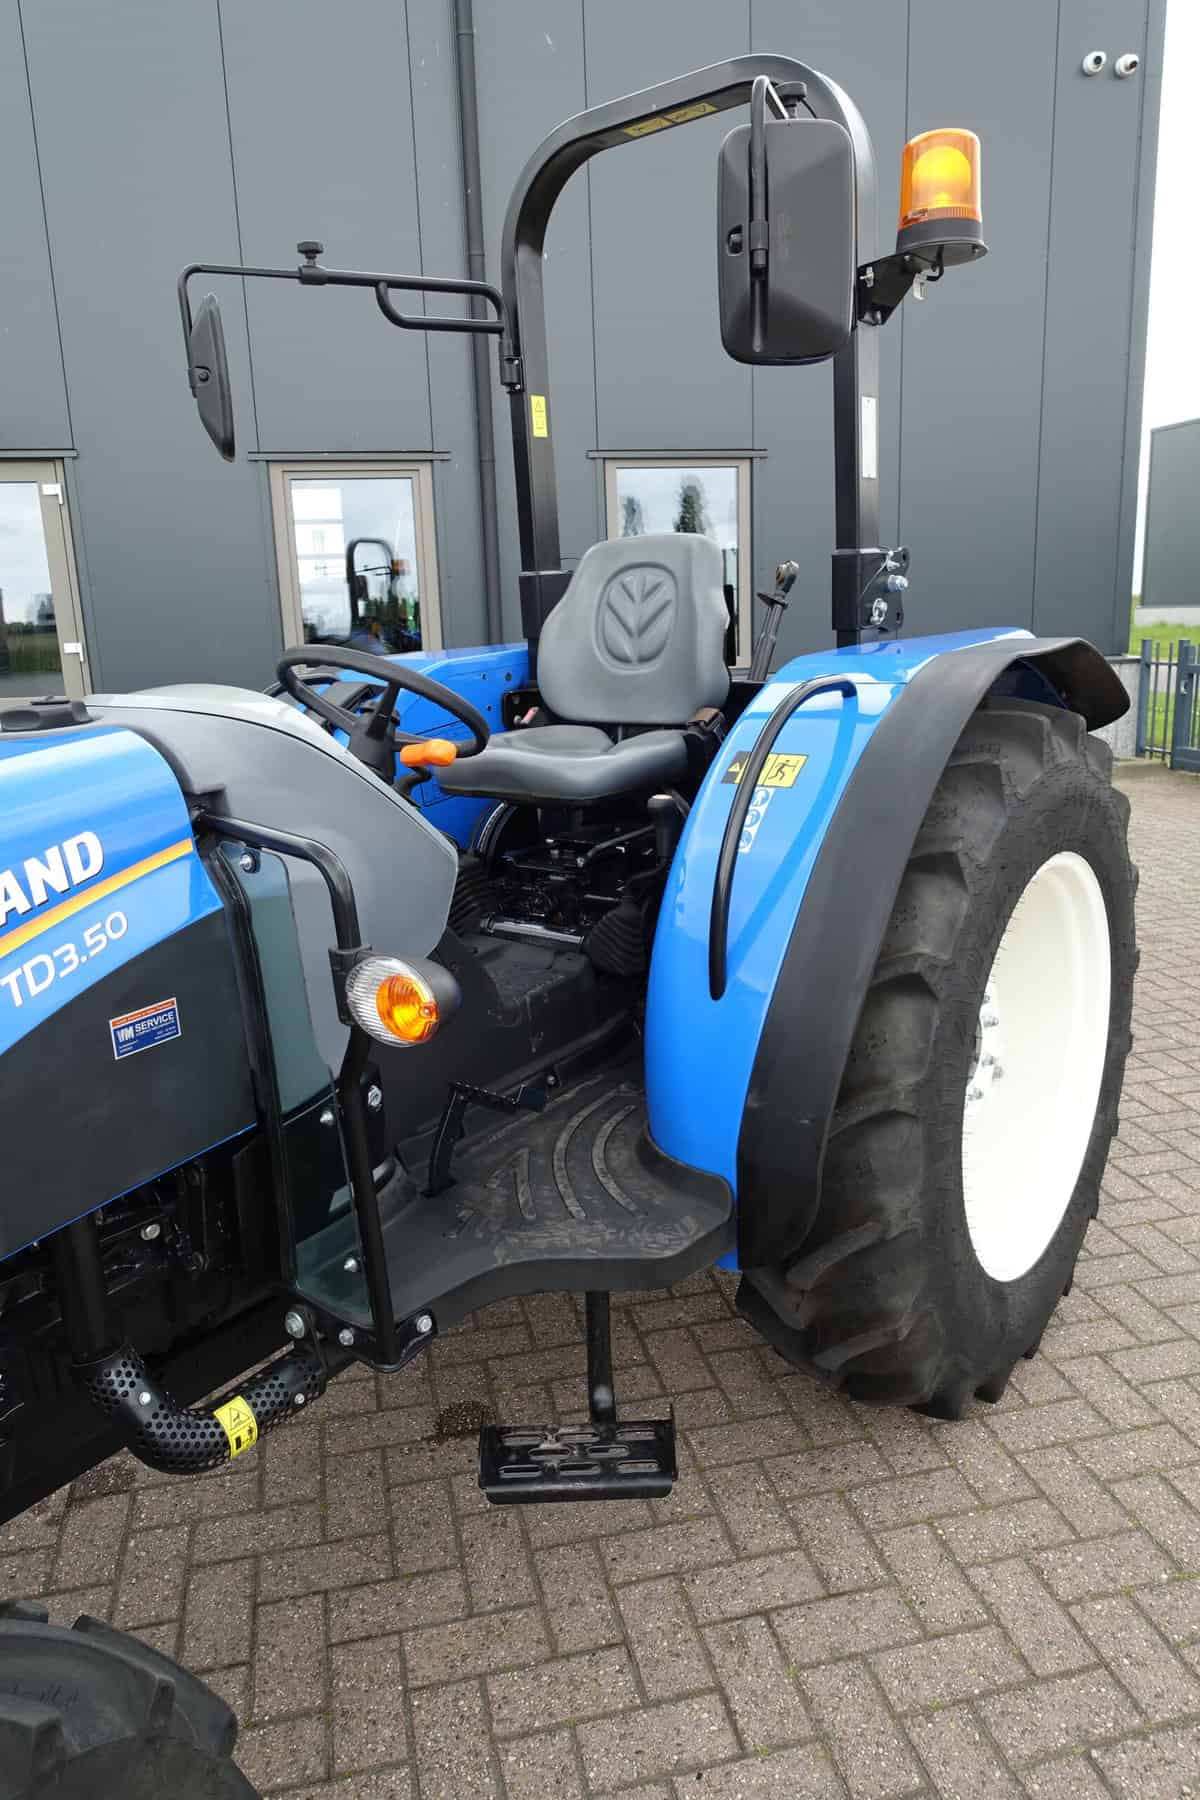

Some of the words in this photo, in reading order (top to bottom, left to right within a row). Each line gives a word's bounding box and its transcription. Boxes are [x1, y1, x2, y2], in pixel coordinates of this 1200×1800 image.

[0, 831, 104, 927] AND
[0, 911, 128, 1007] TD3.50
[135, 1011, 175, 1033] SERVICE
